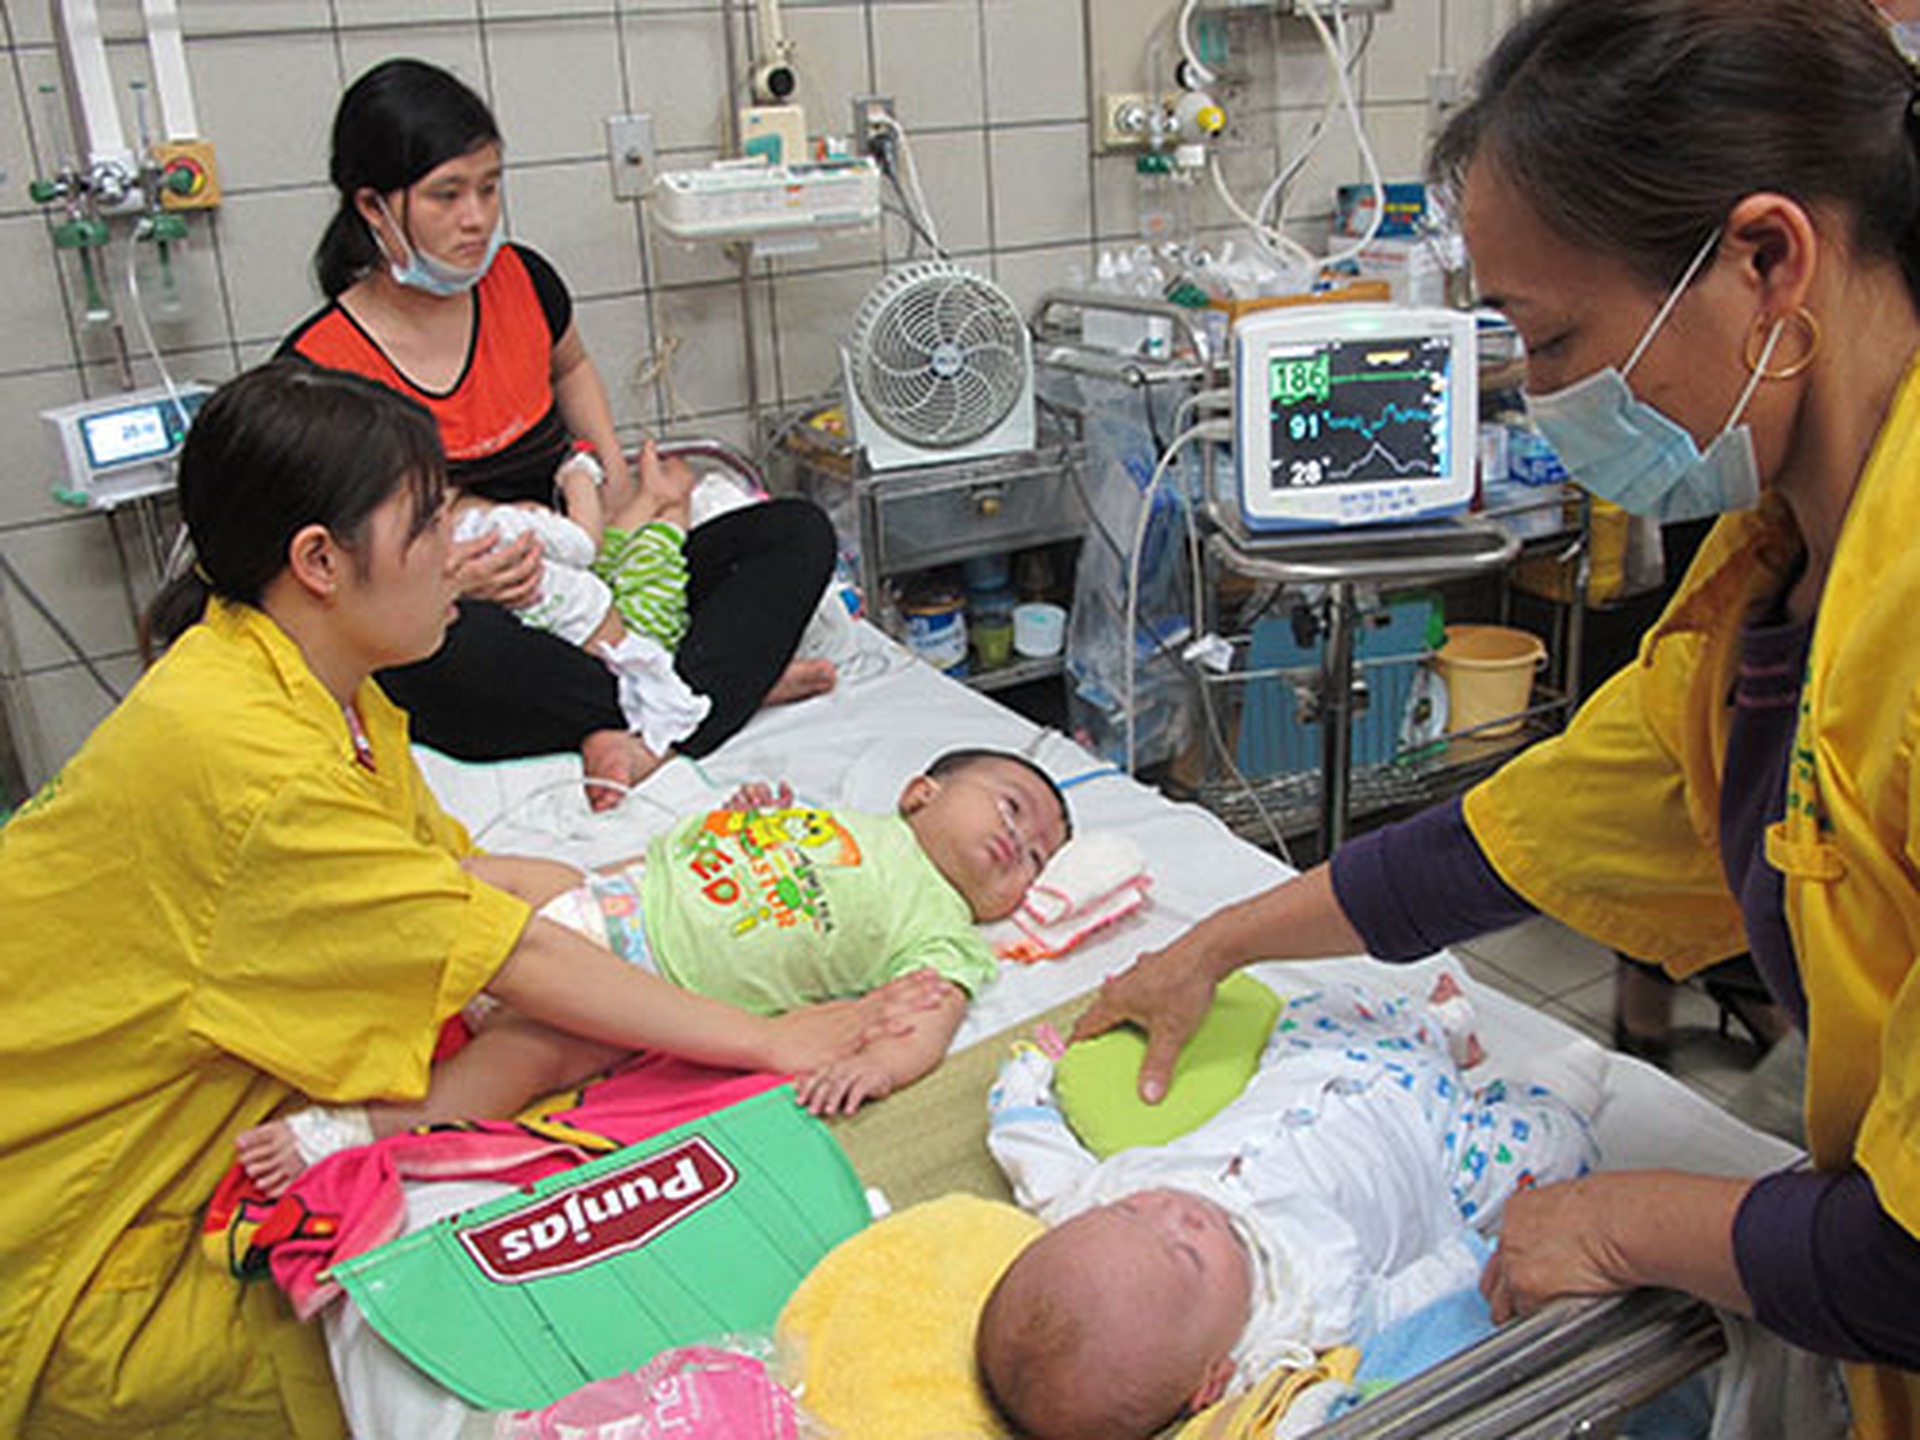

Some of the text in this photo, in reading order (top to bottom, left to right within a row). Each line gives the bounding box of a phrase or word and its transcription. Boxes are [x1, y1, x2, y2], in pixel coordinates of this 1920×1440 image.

[1275, 366, 1327, 394] 186
[1289, 413, 1320, 440] 91
[1290, 460, 1323, 486] 28
[500, 1157, 704, 1261] Punjas
